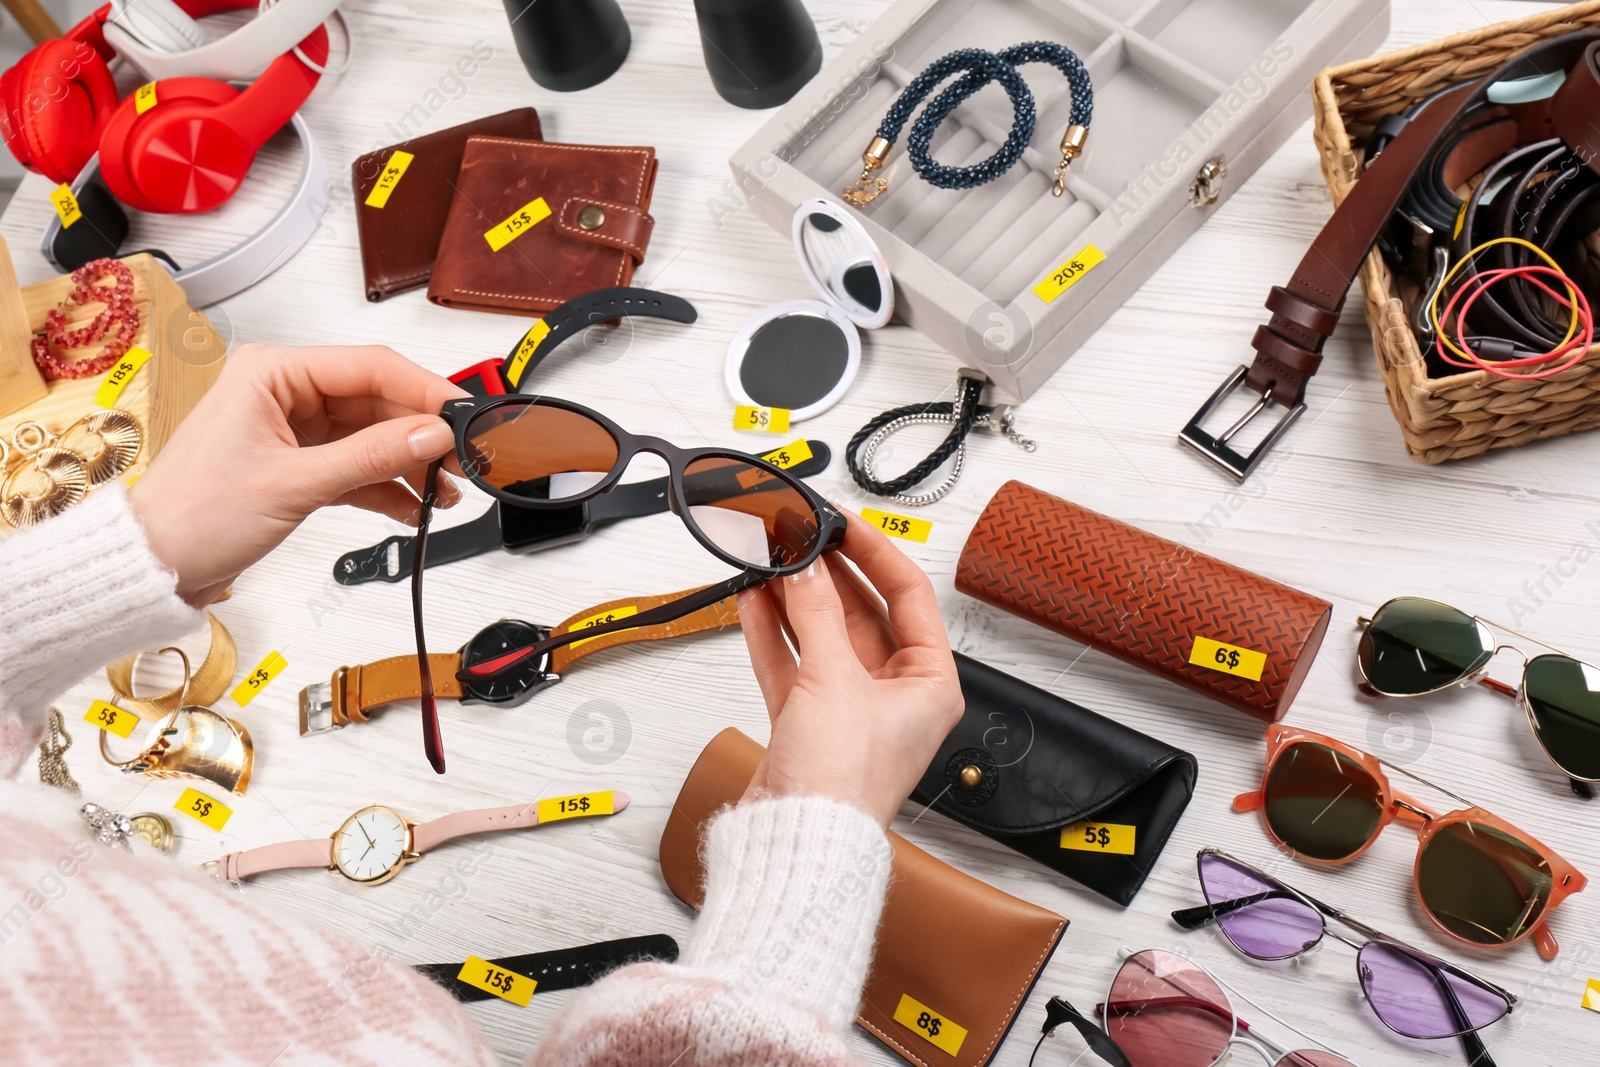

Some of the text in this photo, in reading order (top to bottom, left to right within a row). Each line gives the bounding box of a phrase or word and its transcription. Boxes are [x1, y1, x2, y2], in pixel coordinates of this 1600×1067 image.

[379, 168, 400, 190] 15$
[505, 211, 532, 234] 15$
[1053, 260, 1085, 286] 20$
[516, 337, 536, 365] 15$
[108, 361, 134, 386] 18$
[750, 411, 770, 428] 5$
[881, 516, 910, 535] 15$
[1215, 647, 1241, 669] 6$
[248, 669, 269, 690] 5$
[98, 708, 118, 726] 5$
[191, 798, 213, 817] 5$
[558, 796, 591, 814] 15$
[1084, 826, 1111, 848] 5$
[484, 968, 514, 994] 15$
[916, 1011, 943, 1037] 8$
